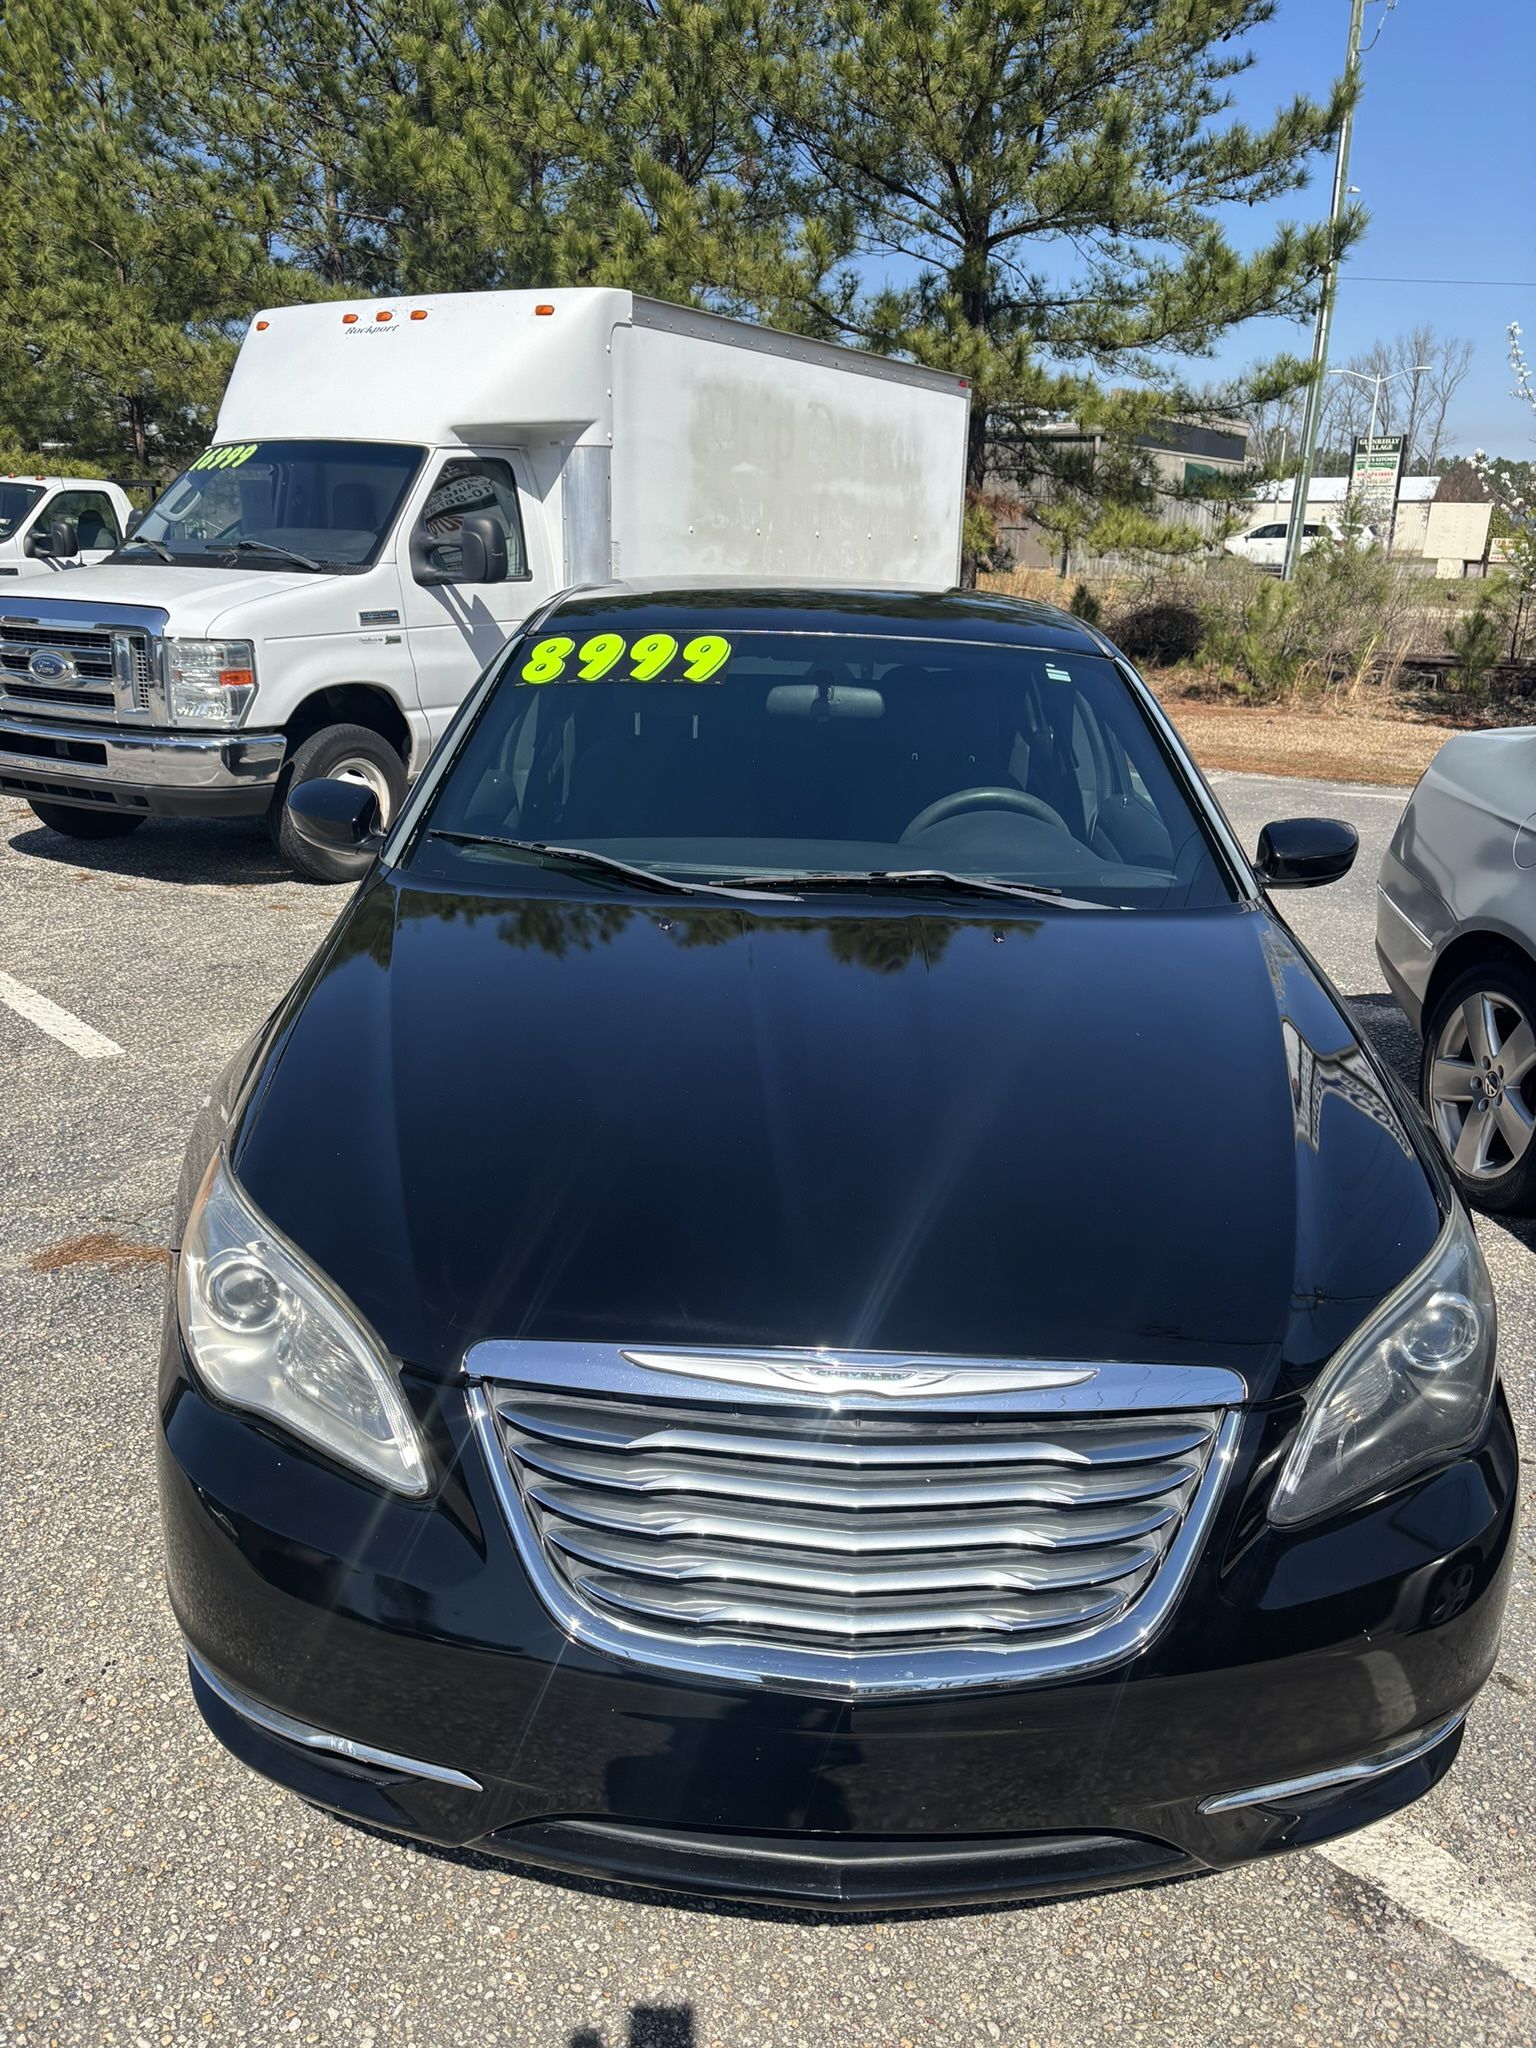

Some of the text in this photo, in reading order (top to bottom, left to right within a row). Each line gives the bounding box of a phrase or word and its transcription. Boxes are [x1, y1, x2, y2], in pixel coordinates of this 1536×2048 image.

[344, 324, 400, 335] Rockport
[188, 443, 258, 472] 16999
[520, 633, 732, 684] 8999
[815, 1369, 902, 1380] CHRYSLER
